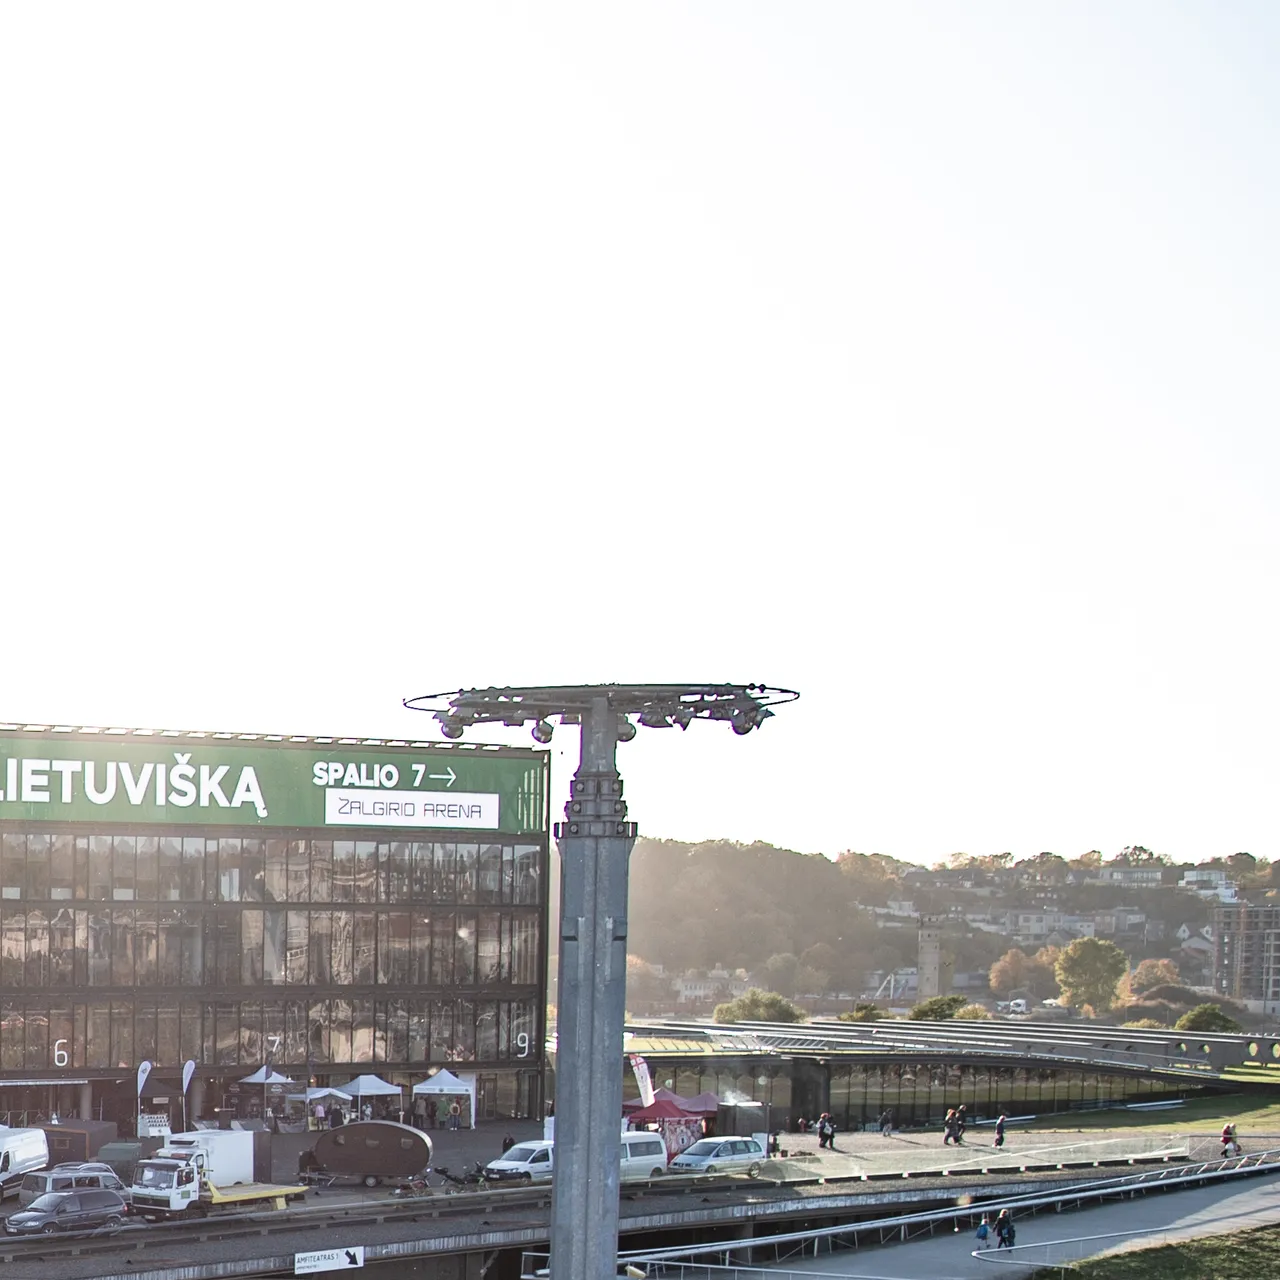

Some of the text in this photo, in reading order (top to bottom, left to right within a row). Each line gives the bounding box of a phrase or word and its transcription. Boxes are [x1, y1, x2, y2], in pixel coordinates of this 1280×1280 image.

[313, 762, 426, 788] SPALIO 7
[424, 803, 482, 819] ARENA
[54, 1039, 68, 1067] 6
[267, 1036, 280, 1052] 7
[516, 1032, 528, 1057] 9
[296, 1253, 335, 1264] AMFITEATRAS
